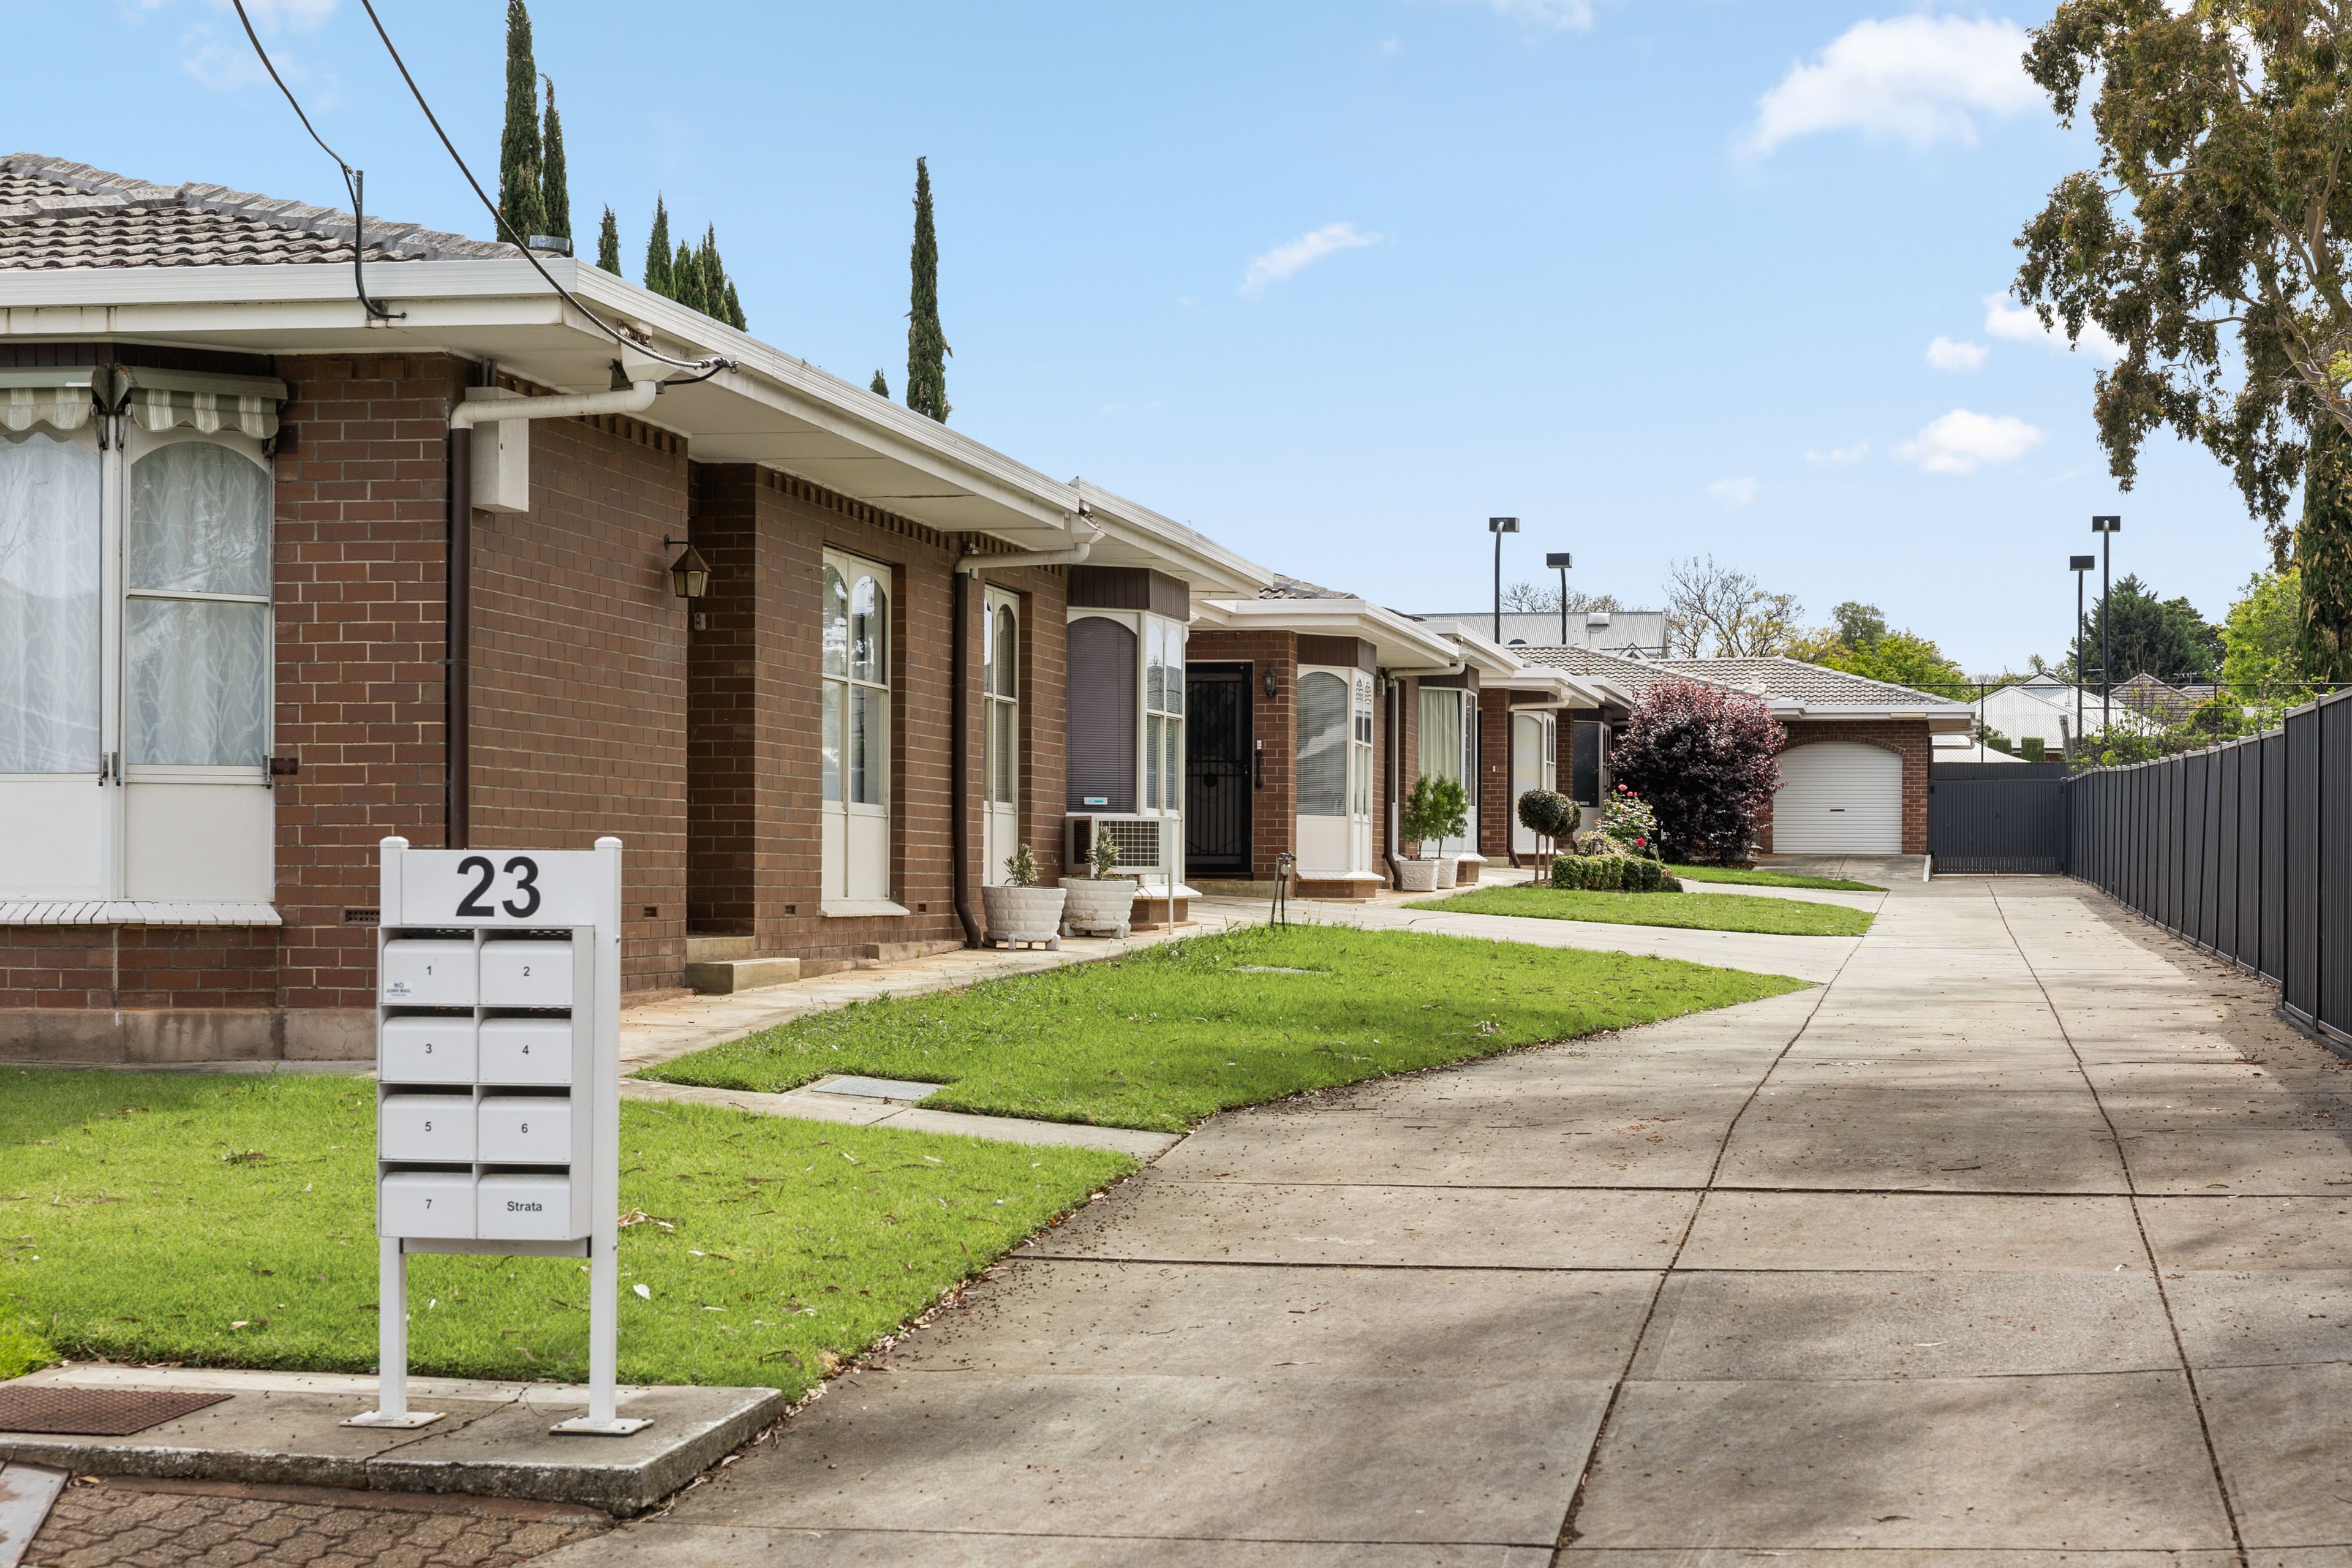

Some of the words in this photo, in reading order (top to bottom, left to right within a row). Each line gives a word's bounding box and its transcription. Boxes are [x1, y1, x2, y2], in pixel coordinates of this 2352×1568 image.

[455, 856, 541, 918] 23
[426, 965, 432, 976] 1
[523, 966, 530, 977] 2
[425, 1043, 432, 1054] 3
[522, 1044, 530, 1055] 4
[424, 1121, 432, 1132] 5
[521, 1123, 529, 1134] 6
[425, 1199, 433, 1210] 7
[507, 1200, 543, 1212] Strata
